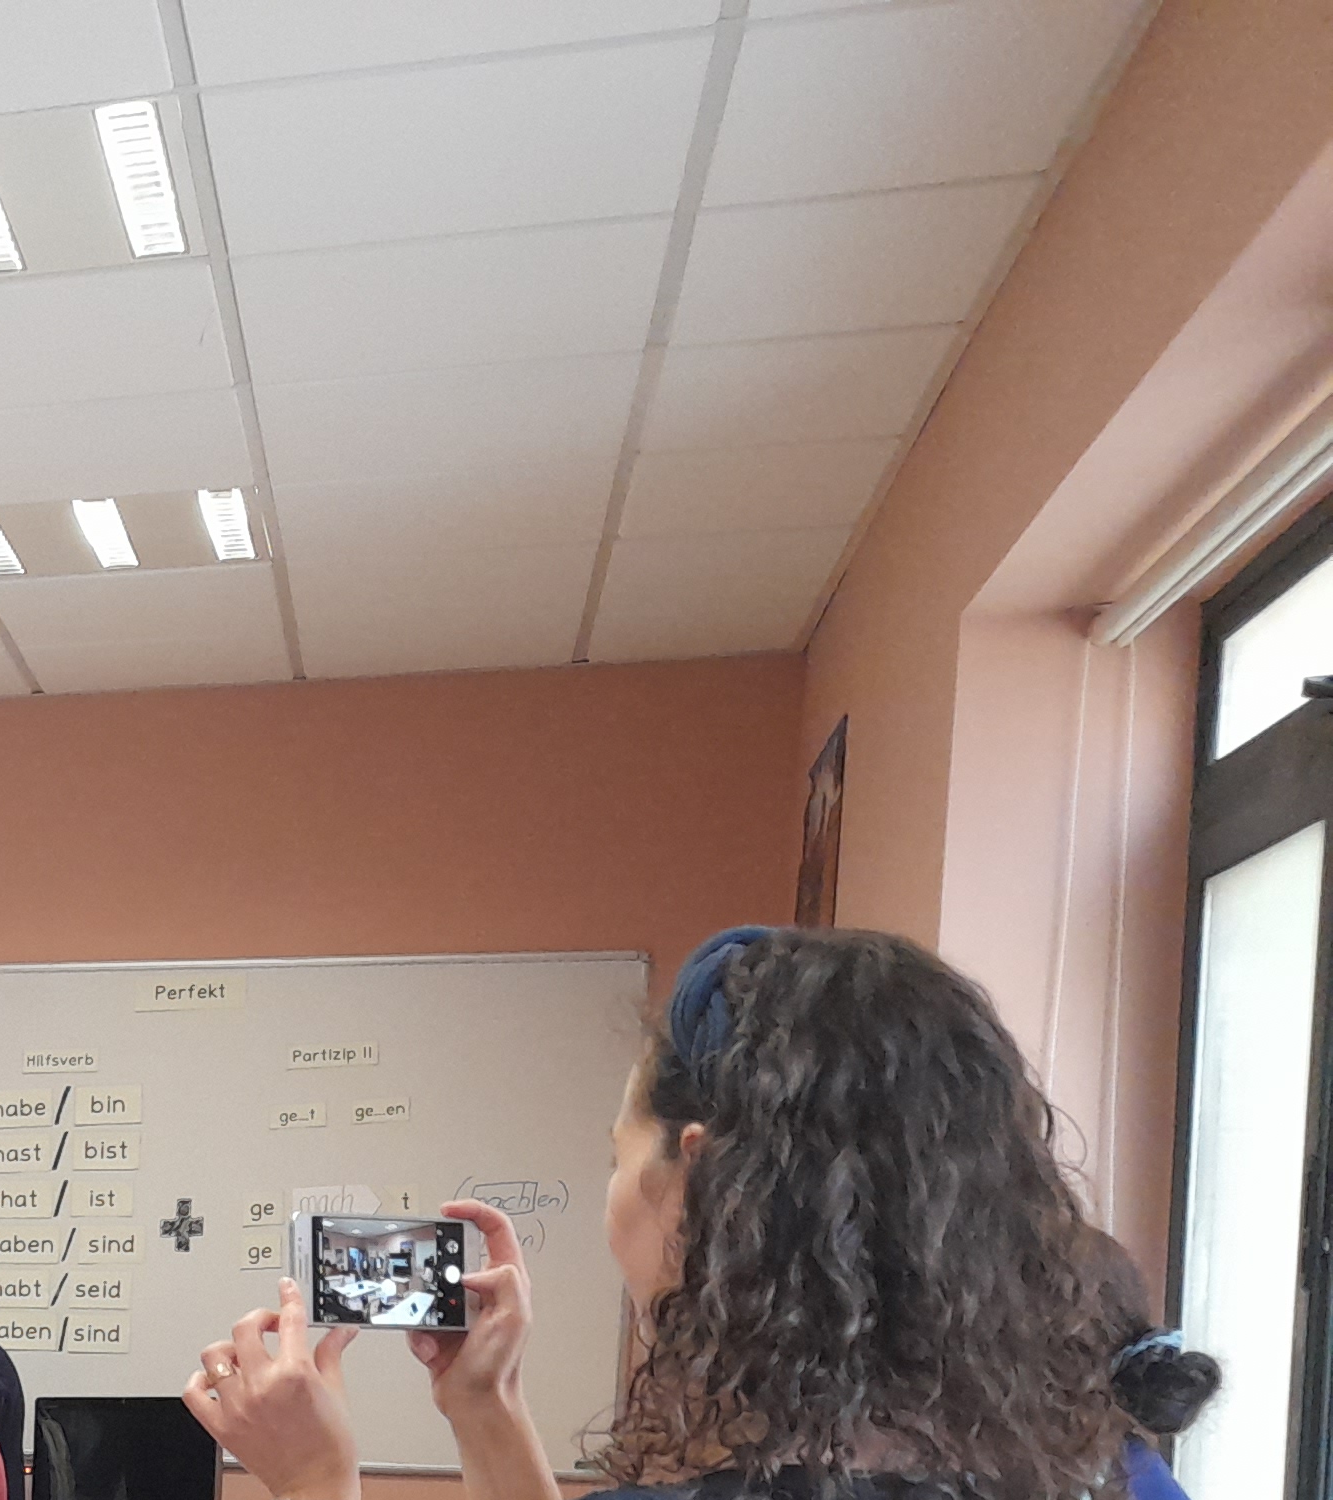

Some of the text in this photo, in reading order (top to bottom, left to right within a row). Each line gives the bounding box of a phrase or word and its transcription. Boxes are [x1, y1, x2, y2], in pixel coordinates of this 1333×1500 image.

[155, 983, 226, 1001] Perfekt
[26, 1054, 94, 1069] Hilfsverb
[292, 1048, 357, 1066] Partizip
[90, 1095, 126, 1114] bin
[84, 1140, 129, 1160] bist
[1, 1189, 38, 1208] hat
[89, 1189, 116, 1208] ist
[250, 1203, 275, 1221] ge
[401, 1192, 411, 1211] t
[88, 1234, 135, 1253] sind
[248, 1246, 272, 1265] ge
[75, 1280, 121, 1299] seid
[73, 1324, 120, 1343] sind
